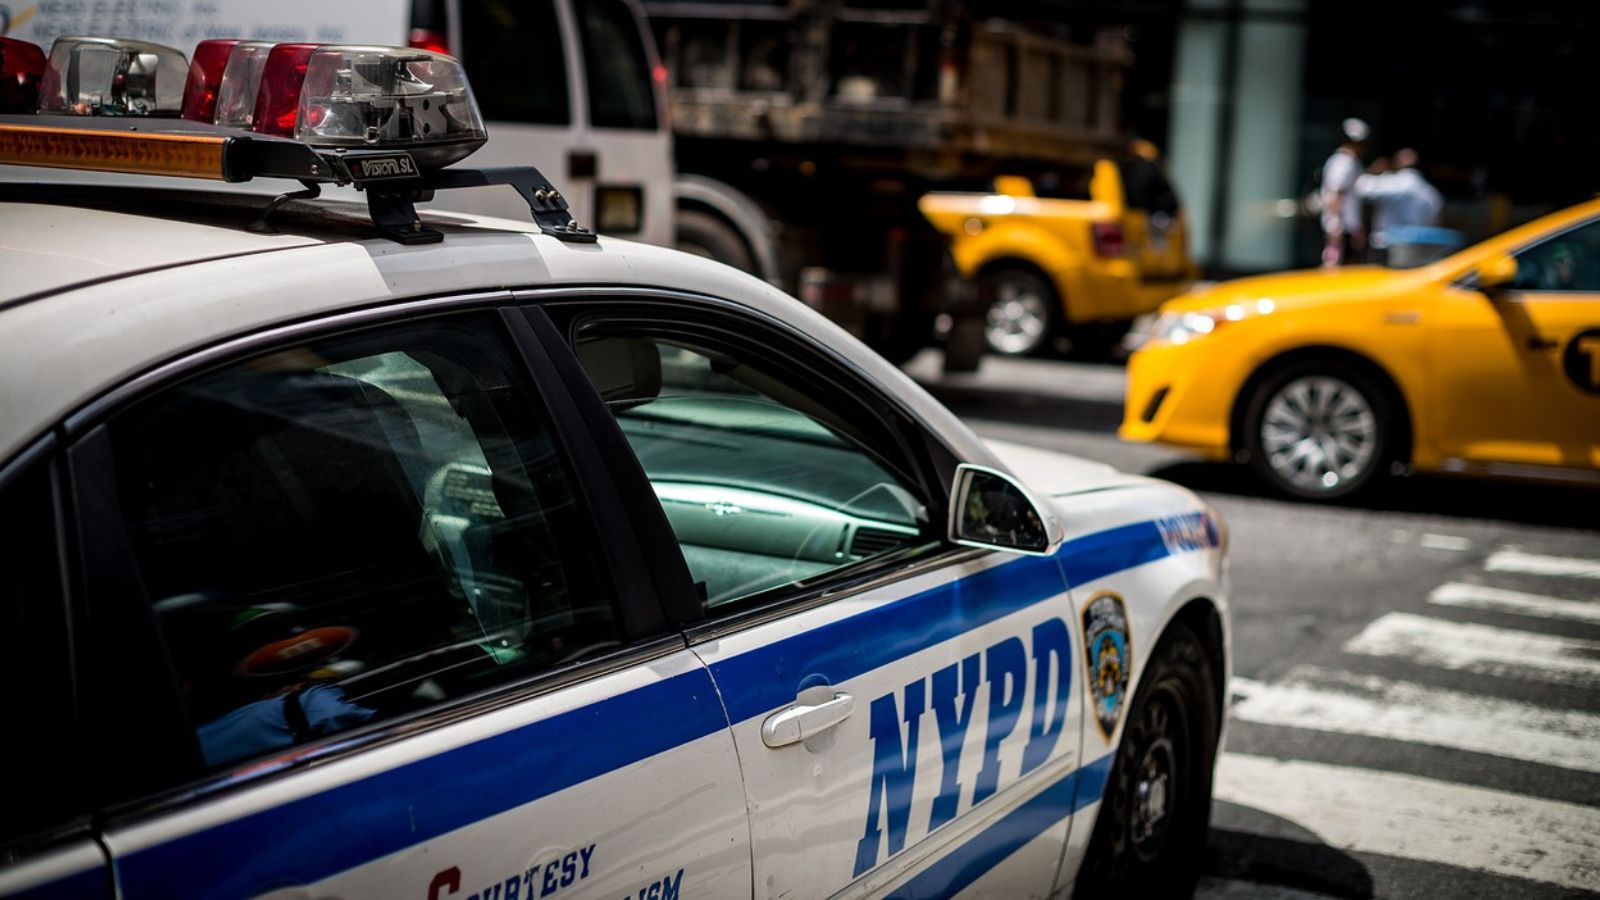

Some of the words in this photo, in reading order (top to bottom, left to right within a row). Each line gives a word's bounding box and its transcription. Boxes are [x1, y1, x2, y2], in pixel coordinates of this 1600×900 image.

[400, 157, 414, 173] SL
[852, 617, 1072, 879] NYPD
[427, 842, 597, 900] CRTESY
